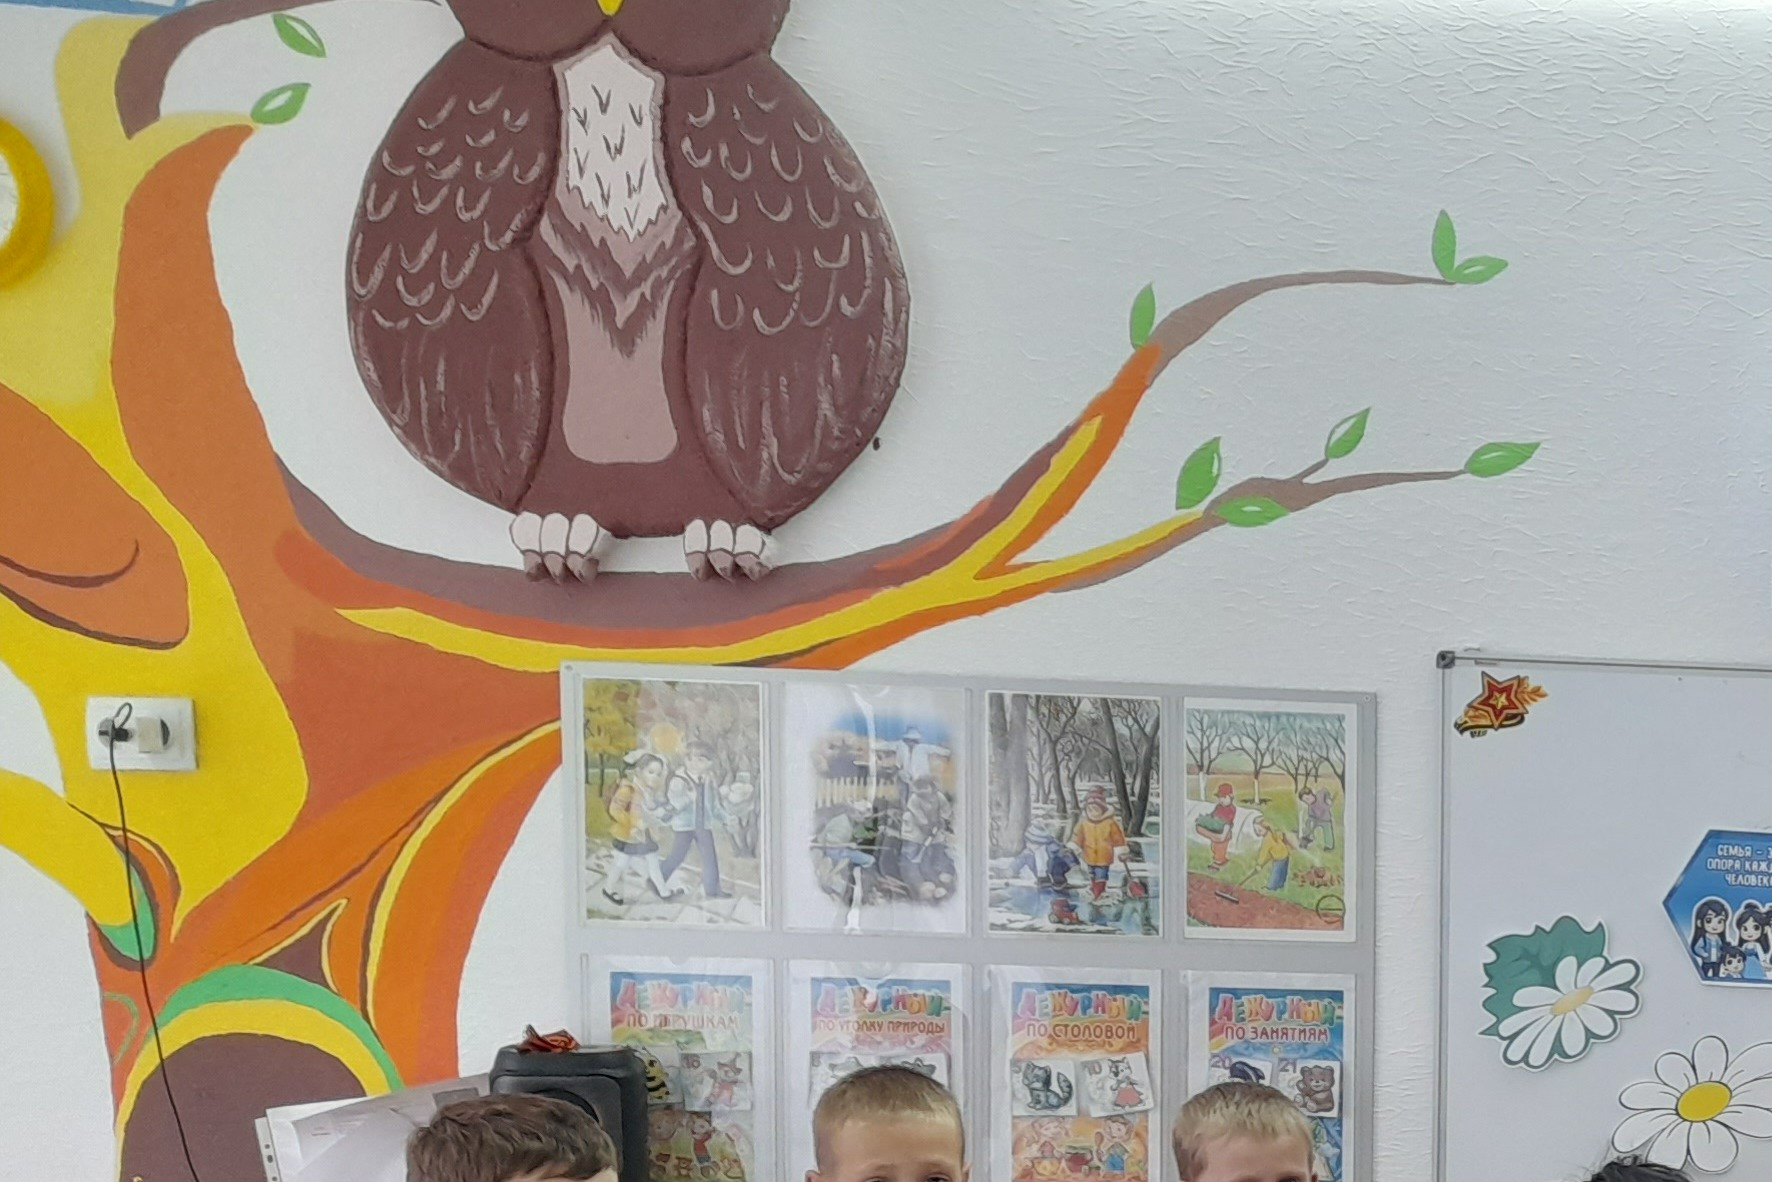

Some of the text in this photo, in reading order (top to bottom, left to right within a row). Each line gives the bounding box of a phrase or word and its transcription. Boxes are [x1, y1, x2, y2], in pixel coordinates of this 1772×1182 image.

[1717, 844, 1751, 857] СЕМЬЯ
[1707, 858, 1741, 870] ОПОРА
[1018, 989, 1142, 1022] ДЕЖУРНЫЙ
[1216, 994, 1336, 1027] ДЕЖУРНЫЙ
[627, 1013, 648, 1028] ПО
[820, 1019, 945, 1036] ПО УГОЛКУ ПРИРОДЫ
[1027, 1022, 1136, 1040] ПО СТОЛОВОЙ
[1225, 1026, 1329, 1042] ПО ЗАНЯТИЯМ
